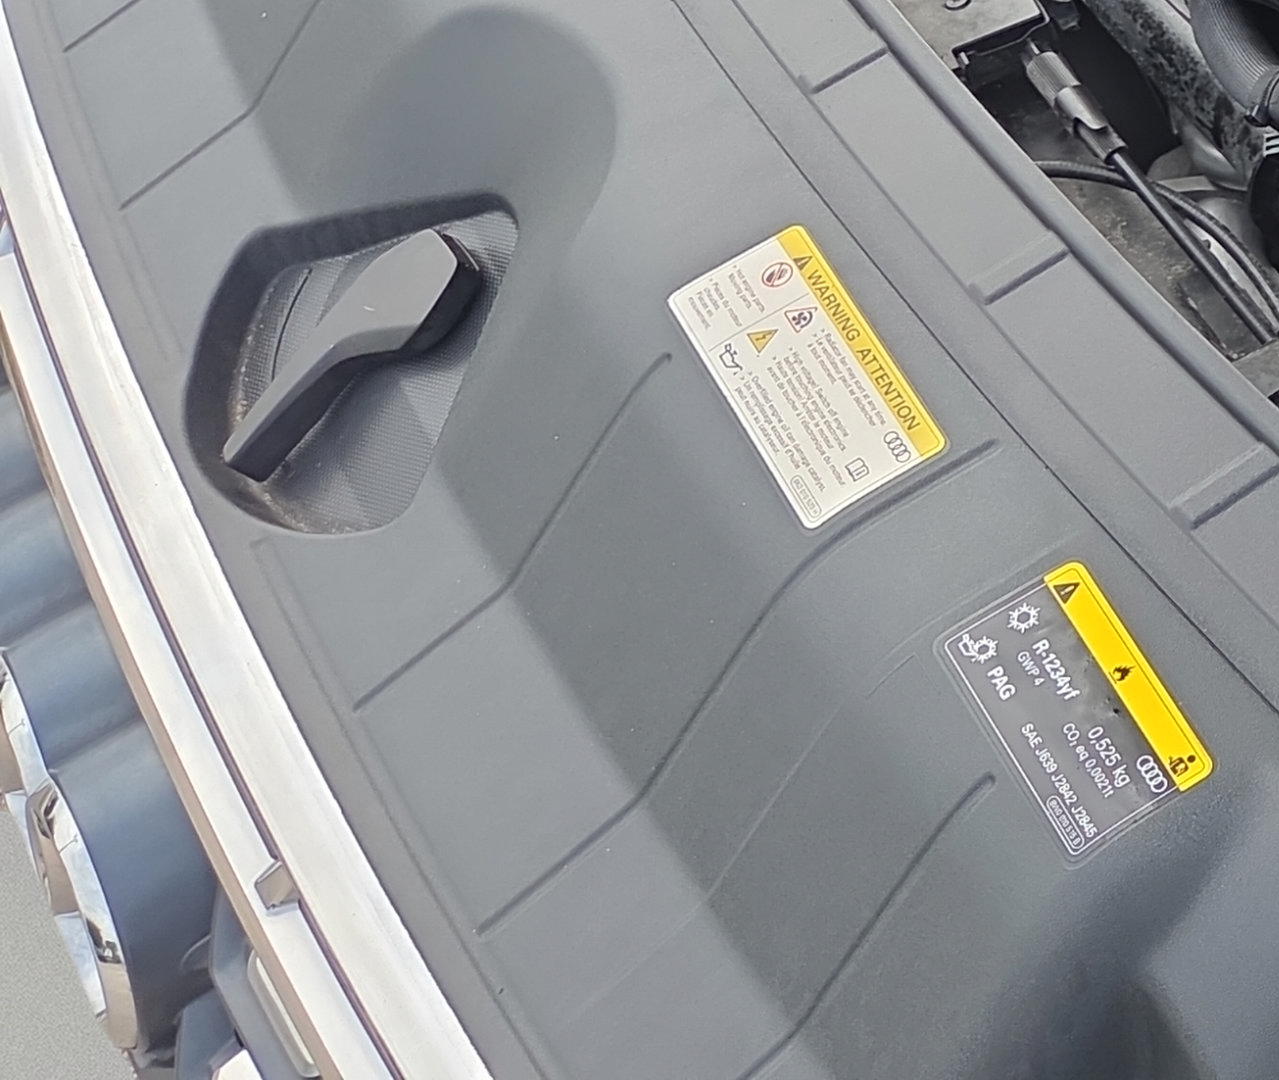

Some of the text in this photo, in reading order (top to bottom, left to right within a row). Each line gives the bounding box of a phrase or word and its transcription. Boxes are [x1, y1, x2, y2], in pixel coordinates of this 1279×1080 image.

[740, 278, 757, 299] engine
[804, 268, 922, 433] WARNING ATTENTION
[814, 337, 824, 347] Le
[790, 350, 805, 367] High
[838, 355, 849, 367] fan
[844, 365, 858, 380] may
[852, 378, 866, 394] start
[861, 392, 871, 400] at
[866, 398, 878, 411] any
[809, 399, 827, 420] engine
[813, 387, 833, 410] Switch
[766, 402, 786, 425] engine
[826, 407, 838, 418] off
[778, 422, 791, 433] oil
[784, 430, 798, 444] can
[831, 415, 850, 438] engine
[791, 441, 813, 468] damage
[1014, 648, 1041, 680] GWP
[1030, 673, 1046, 687] 4
[1071, 743, 1091, 763] eq
[1081, 756, 1117, 800] 0,0021t
[1027, 636, 1136, 790] R-1234yf 0,525 kg
[984, 664, 1099, 839] PAG SAE J639 J2842 J2845
